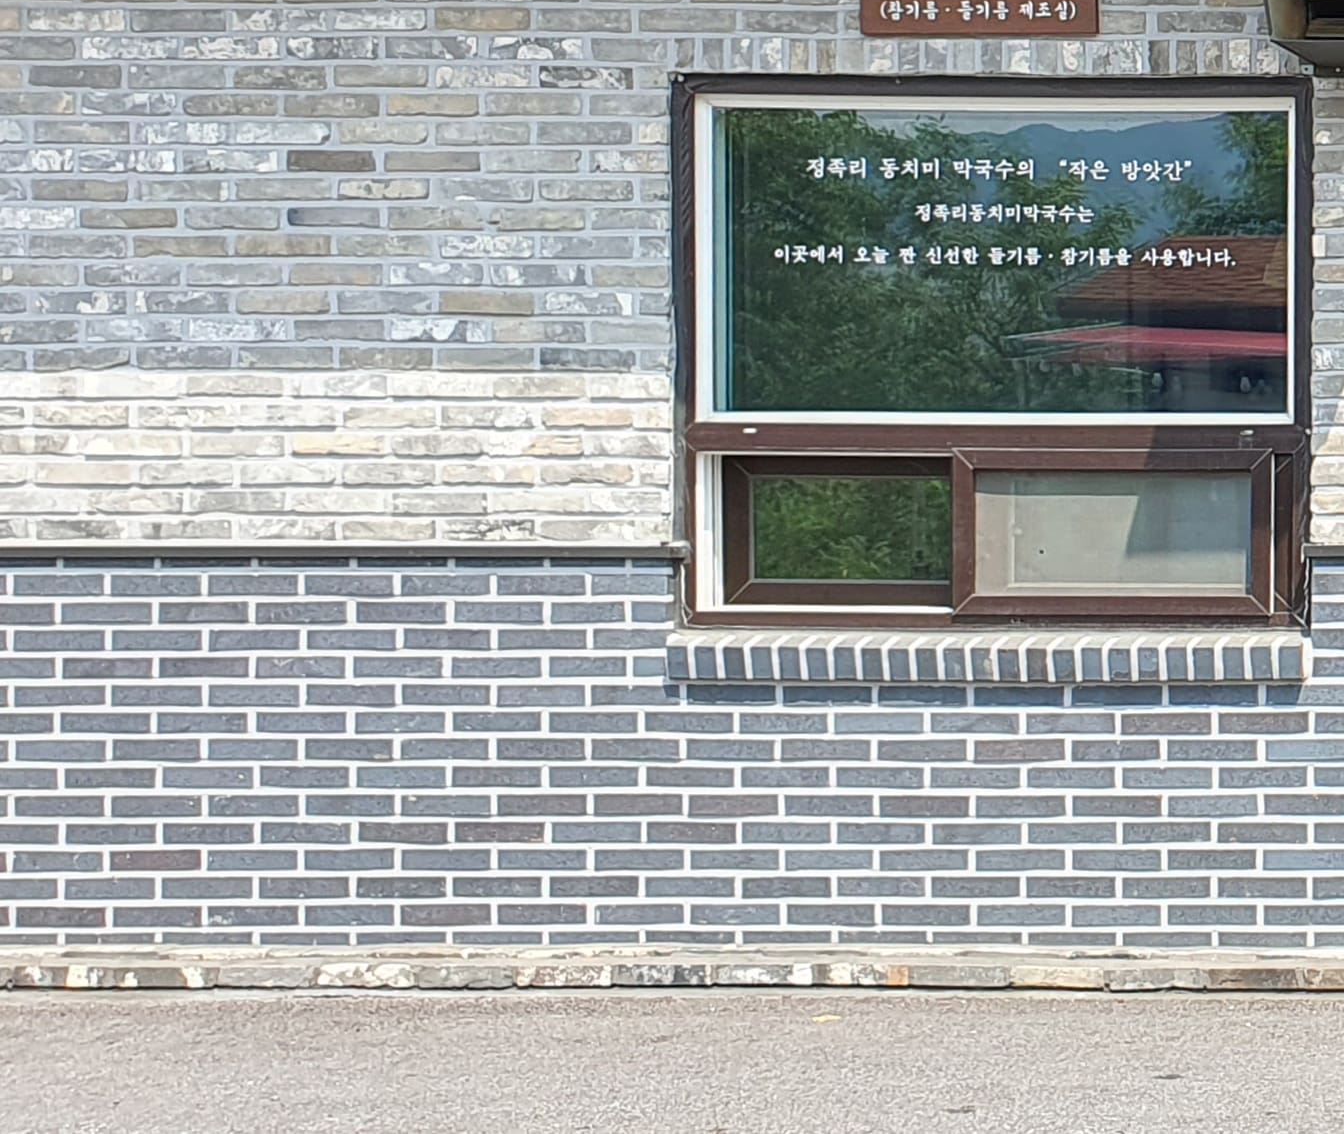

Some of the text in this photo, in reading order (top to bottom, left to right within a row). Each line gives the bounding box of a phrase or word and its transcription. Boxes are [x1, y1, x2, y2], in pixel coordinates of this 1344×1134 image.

[1019, 0, 1077, 21] 제조실)
[806, 156, 867, 180] 정족리
[879, 157, 941, 181] 동치미
[952, 158, 1034, 181] 막국수의
[915, 202, 1095, 224] 정족리동치미막국수는
[774, 245, 843, 265] 이곳에서
[853, 246, 890, 265] 오늘
[898, 246, 917, 265] 짠
[925, 246, 979, 266] 신선한
[1141, 247, 1237, 268] 사용합니다.
